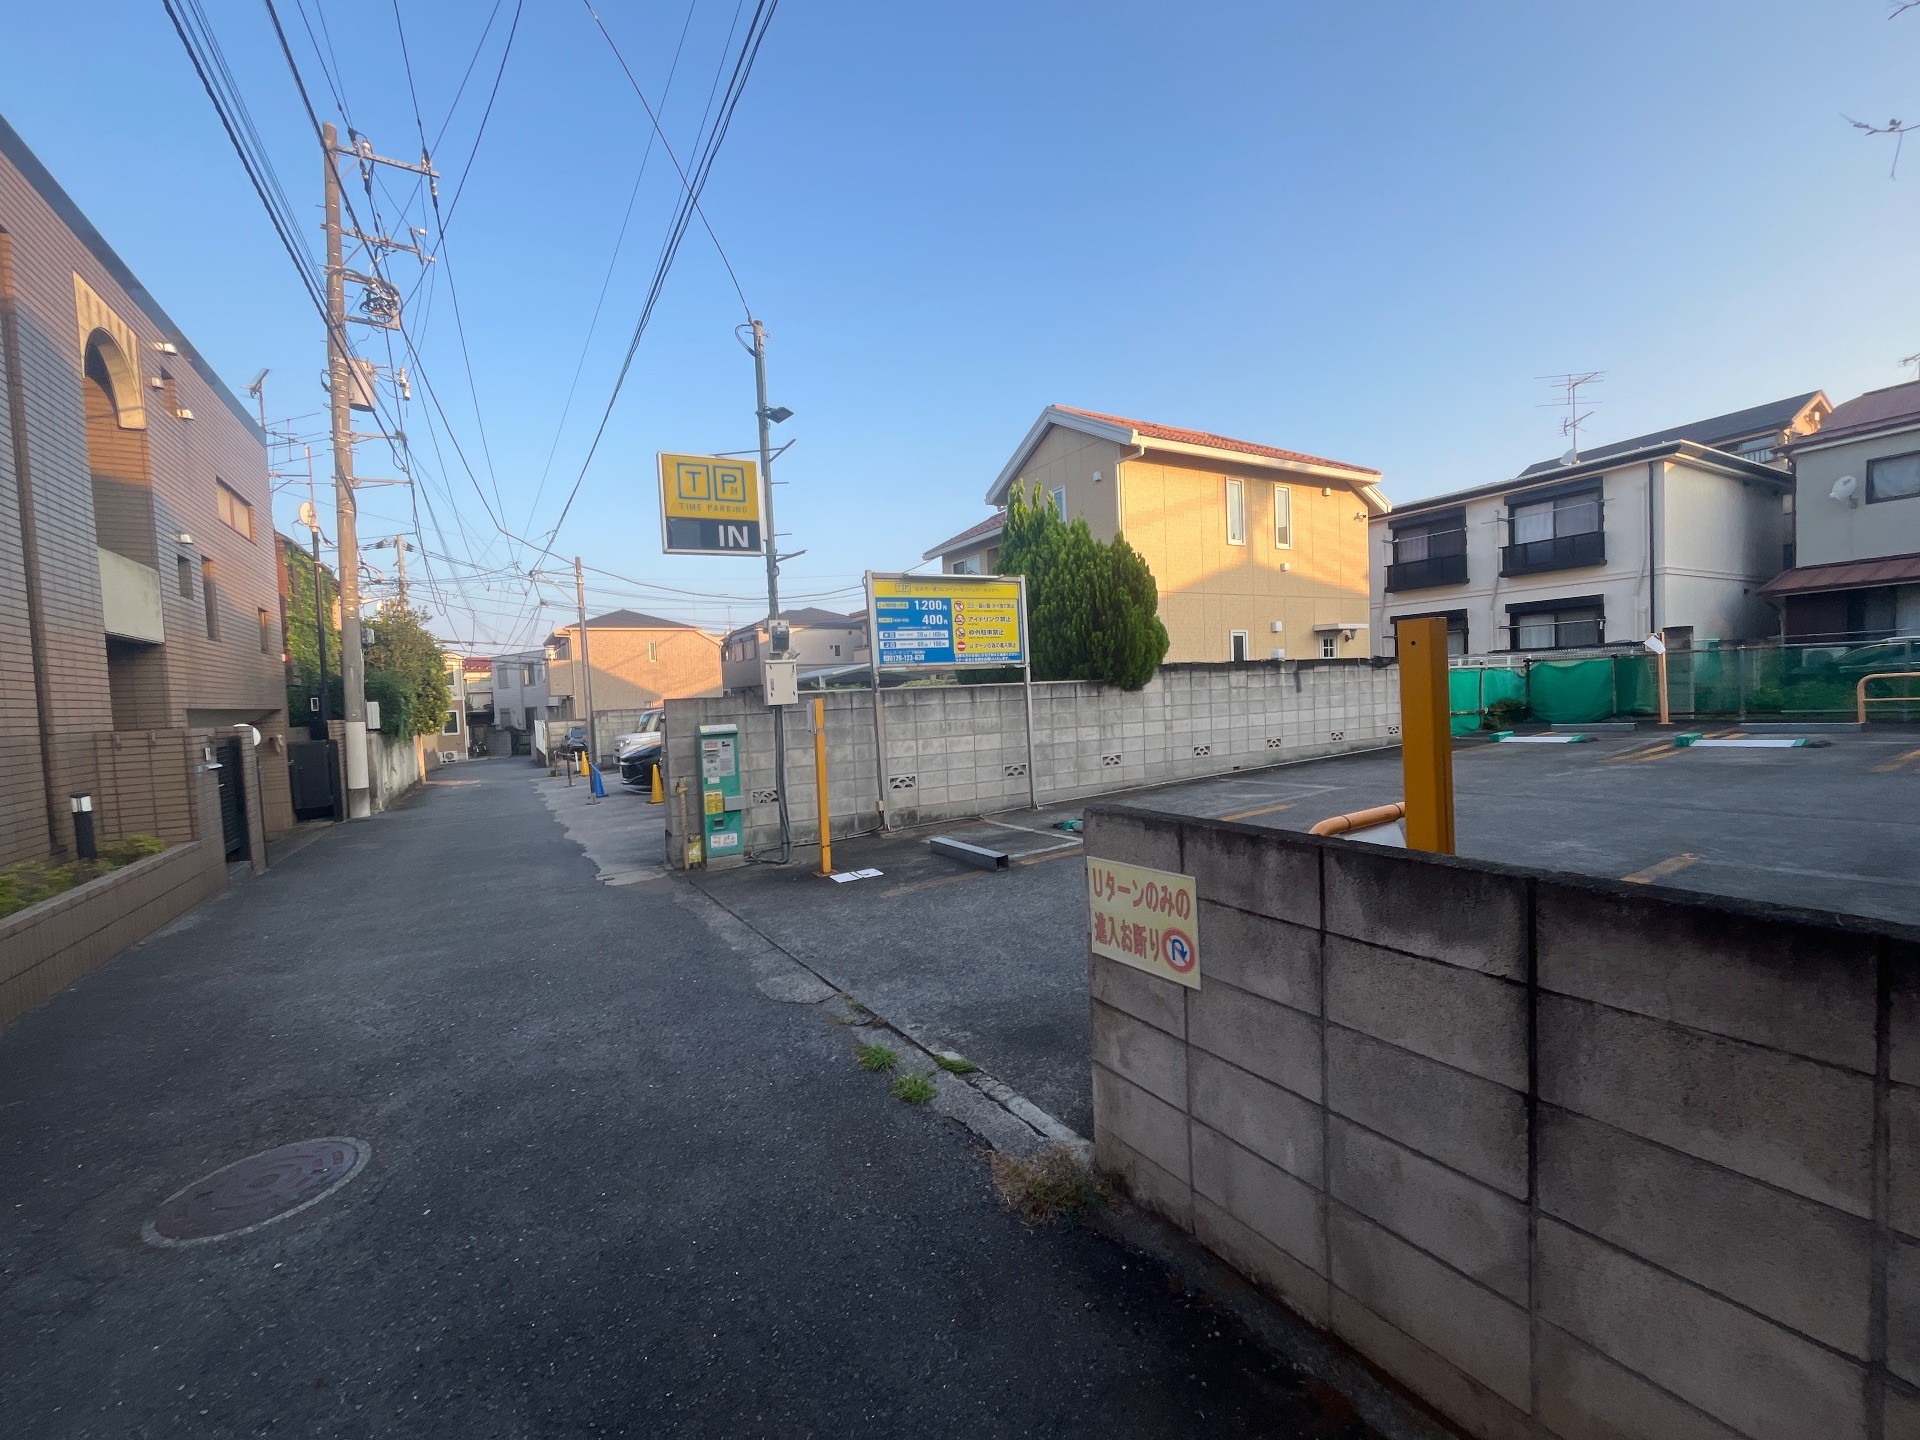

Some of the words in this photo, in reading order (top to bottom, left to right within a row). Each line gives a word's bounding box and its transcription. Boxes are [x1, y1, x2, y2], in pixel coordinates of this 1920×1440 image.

[685, 471, 702, 492] T
[721, 473, 738, 494] P
[679, 502, 702, 512] TIME
[707, 504, 748, 514] PARKING
[718, 524, 750, 548] IN
[1092, 867, 1191, 921] Uターンのみの
[1094, 911, 1160, 962] 進入お断り
